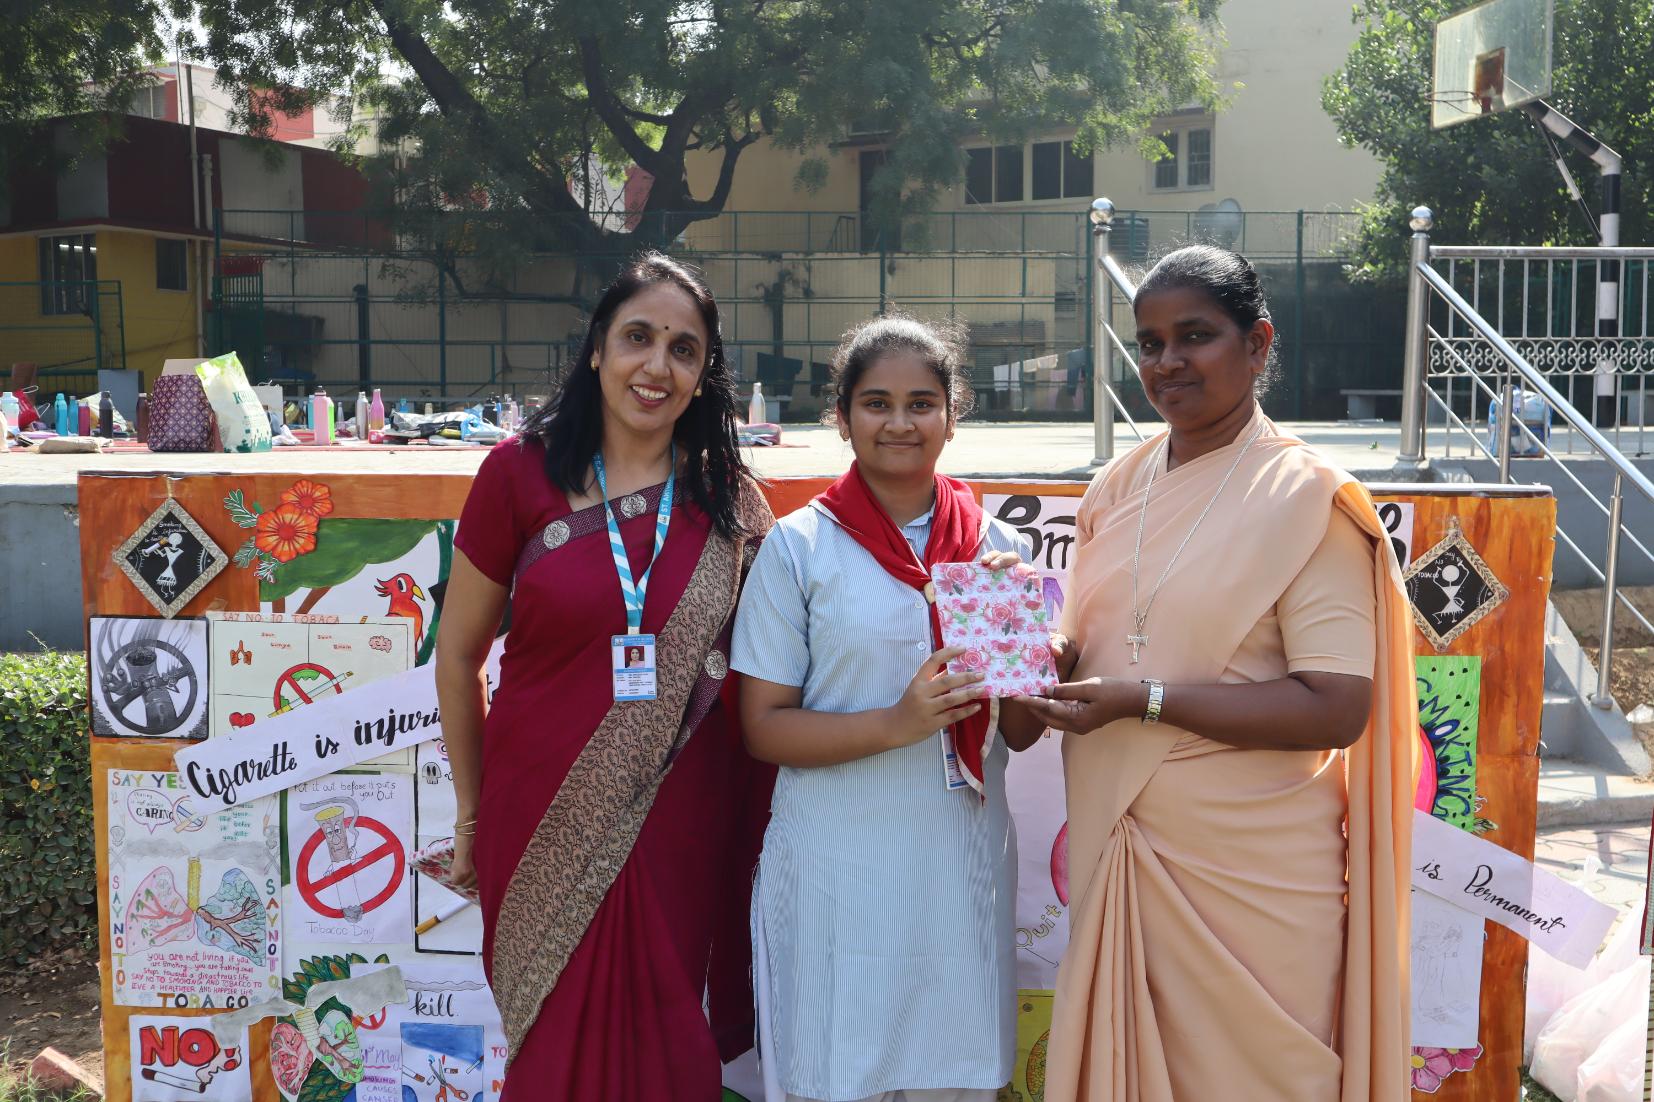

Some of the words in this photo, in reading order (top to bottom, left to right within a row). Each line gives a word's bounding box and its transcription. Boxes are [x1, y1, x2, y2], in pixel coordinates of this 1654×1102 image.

[246, 613, 263, 623] NO
[186, 741, 298, 805] Cigarette
[315, 734, 340, 759] is
[353, 707, 442, 747] injuri
[112, 771, 145, 786] SAY
[312, 779, 320, 791] it
[322, 782, 336, 792] out
[340, 781, 367, 797] before
[368, 780, 375, 790] it
[376, 781, 397, 794] puts
[359, 791, 375, 801] you
[376, 789, 395, 800] Out
[112, 875, 124, 919] SAY
[266, 878, 279, 928] SAY
[1416, 859, 1444, 882] is
[1463, 864, 1566, 934] Permanent
[352, 922, 376, 943] Day
[1015, 904, 1063, 949] Quit
[147, 953, 165, 963] you
[168, 953, 184, 962] are
[185, 951, 200, 962] not
[202, 951, 224, 964] living
[228, 954, 235, 962] if
[236, 956, 249, 965] you
[131, 973, 144, 981] SAY
[205, 979, 220, 987] AND
